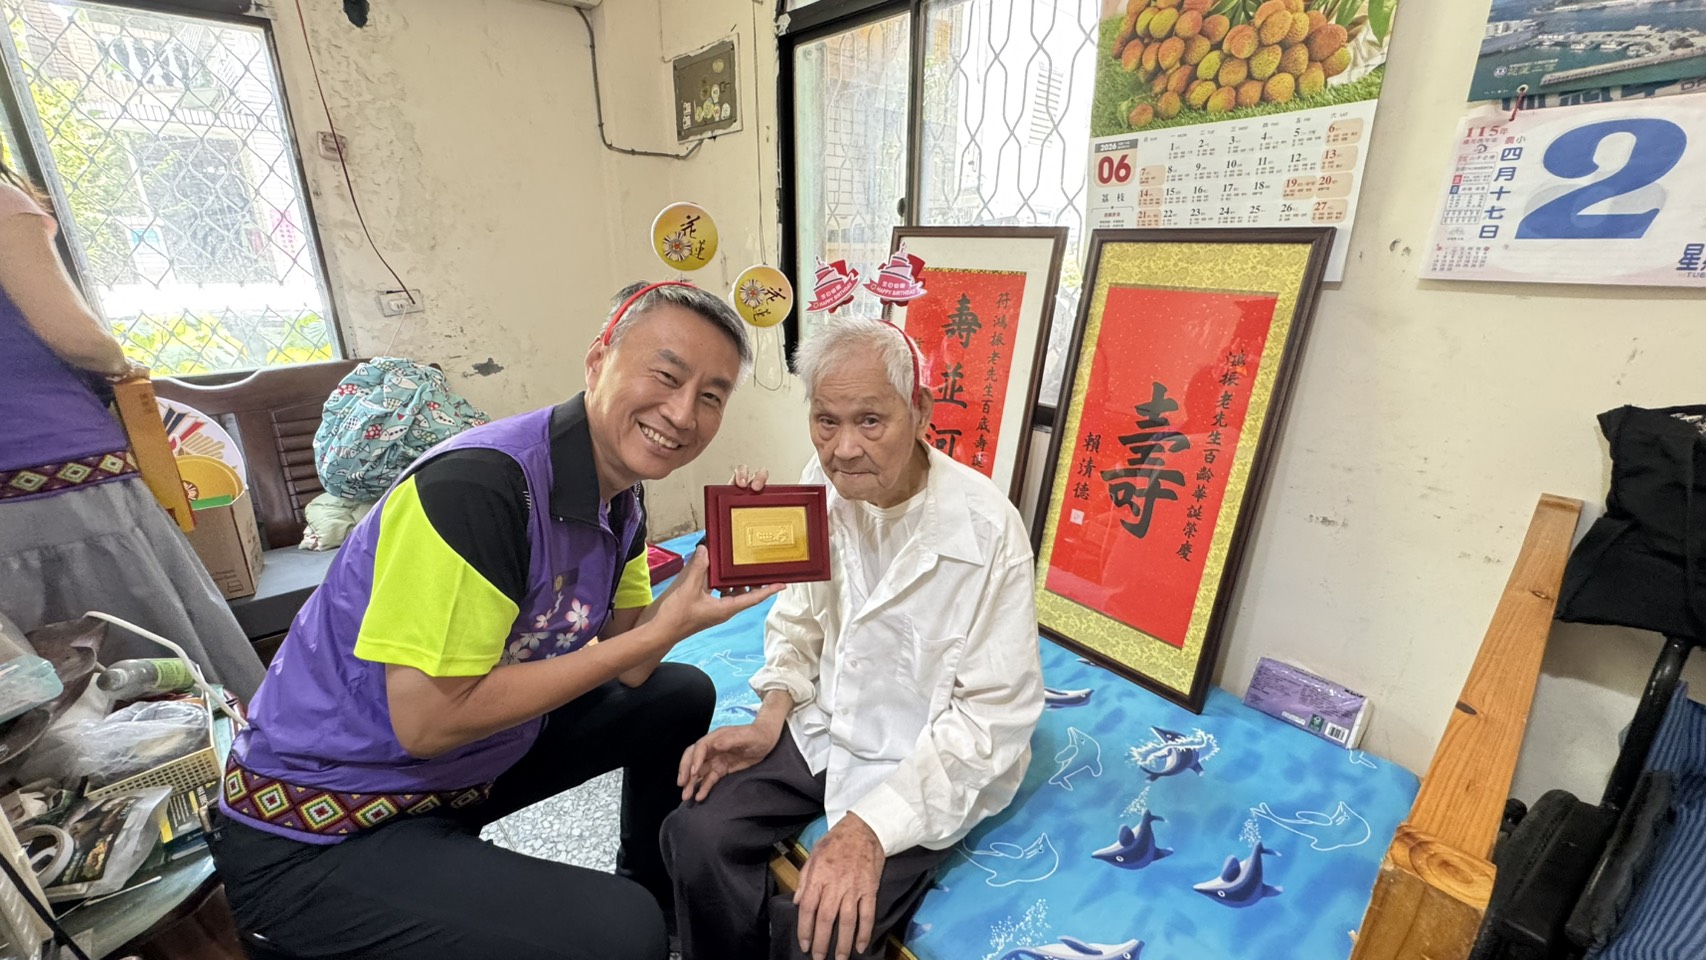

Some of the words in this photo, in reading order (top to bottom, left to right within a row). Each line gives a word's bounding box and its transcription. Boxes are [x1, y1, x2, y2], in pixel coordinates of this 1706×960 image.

[1100, 143, 1117, 151] 2026
[1170, 143, 1175, 151] 1
[1198, 139, 1204, 147] 2
[1229, 136, 1235, 145] 3
[1261, 132, 1267, 141] 4
[1293, 128, 1300, 137] 5
[1328, 123, 1335, 133] 6
[1097, 153, 1132, 185] 06
[1140, 168, 1146, 176] 7
[1167, 166, 1173, 174] 8
[1196, 163, 1201, 171] 9
[1226, 160, 1237, 169] 10
[1258, 157, 1267, 166] 11
[1290, 153, 1301, 162] 12
[1324, 149, 1336, 159] 13
[1140, 189, 1149, 198] 14
[1166, 187, 1175, 196] 15
[1193, 186, 1203, 194] 16
[1223, 183, 1233, 192] 17
[1254, 181, 1265, 190] 18
[1286, 179, 1297, 188] 19
[1319, 176, 1332, 185] 20
[1479, 147, 1523, 239] 四月十七日
[1514, 118, 1688, 240] 2
[1138, 211, 1147, 219] 21
[1163, 209, 1173, 218] 22
[1190, 208, 1201, 217] 23
[1219, 207, 1230, 215] 24
[1249, 205, 1261, 214] 25
[1280, 204, 1293, 213] 26
[1314, 201, 1327, 211] 27
[1676, 243, 1706, 271] 星
[819, 297, 834, 307] HAPPY
[834, 282, 853, 300] BIRTHDAY
[876, 287, 892, 295] HAPPY
[892, 288, 916, 296] BIRTHDAY
[1073, 432, 1101, 501] 賴清德
[1100, 381, 1191, 539] 壽
